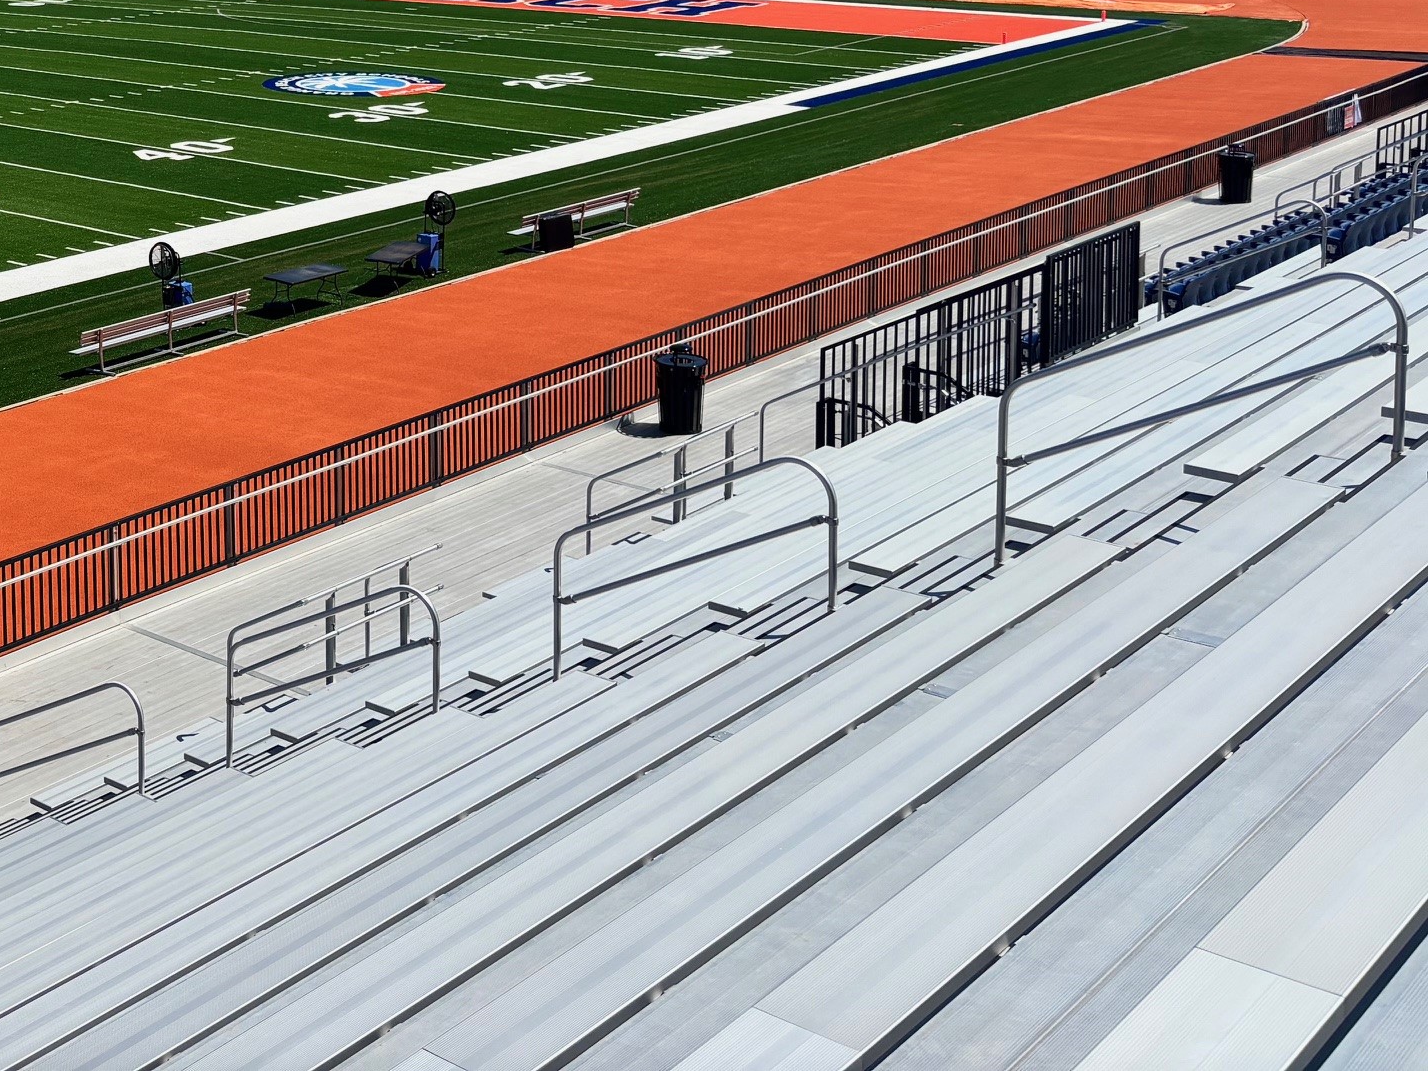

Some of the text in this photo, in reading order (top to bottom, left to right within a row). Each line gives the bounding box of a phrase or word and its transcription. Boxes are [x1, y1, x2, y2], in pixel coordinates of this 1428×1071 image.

[654, 46, 734, 60] 10
[502, 73, 595, 90] 20
[328, 104, 430, 123] 30
[132, 138, 235, 161] 40
